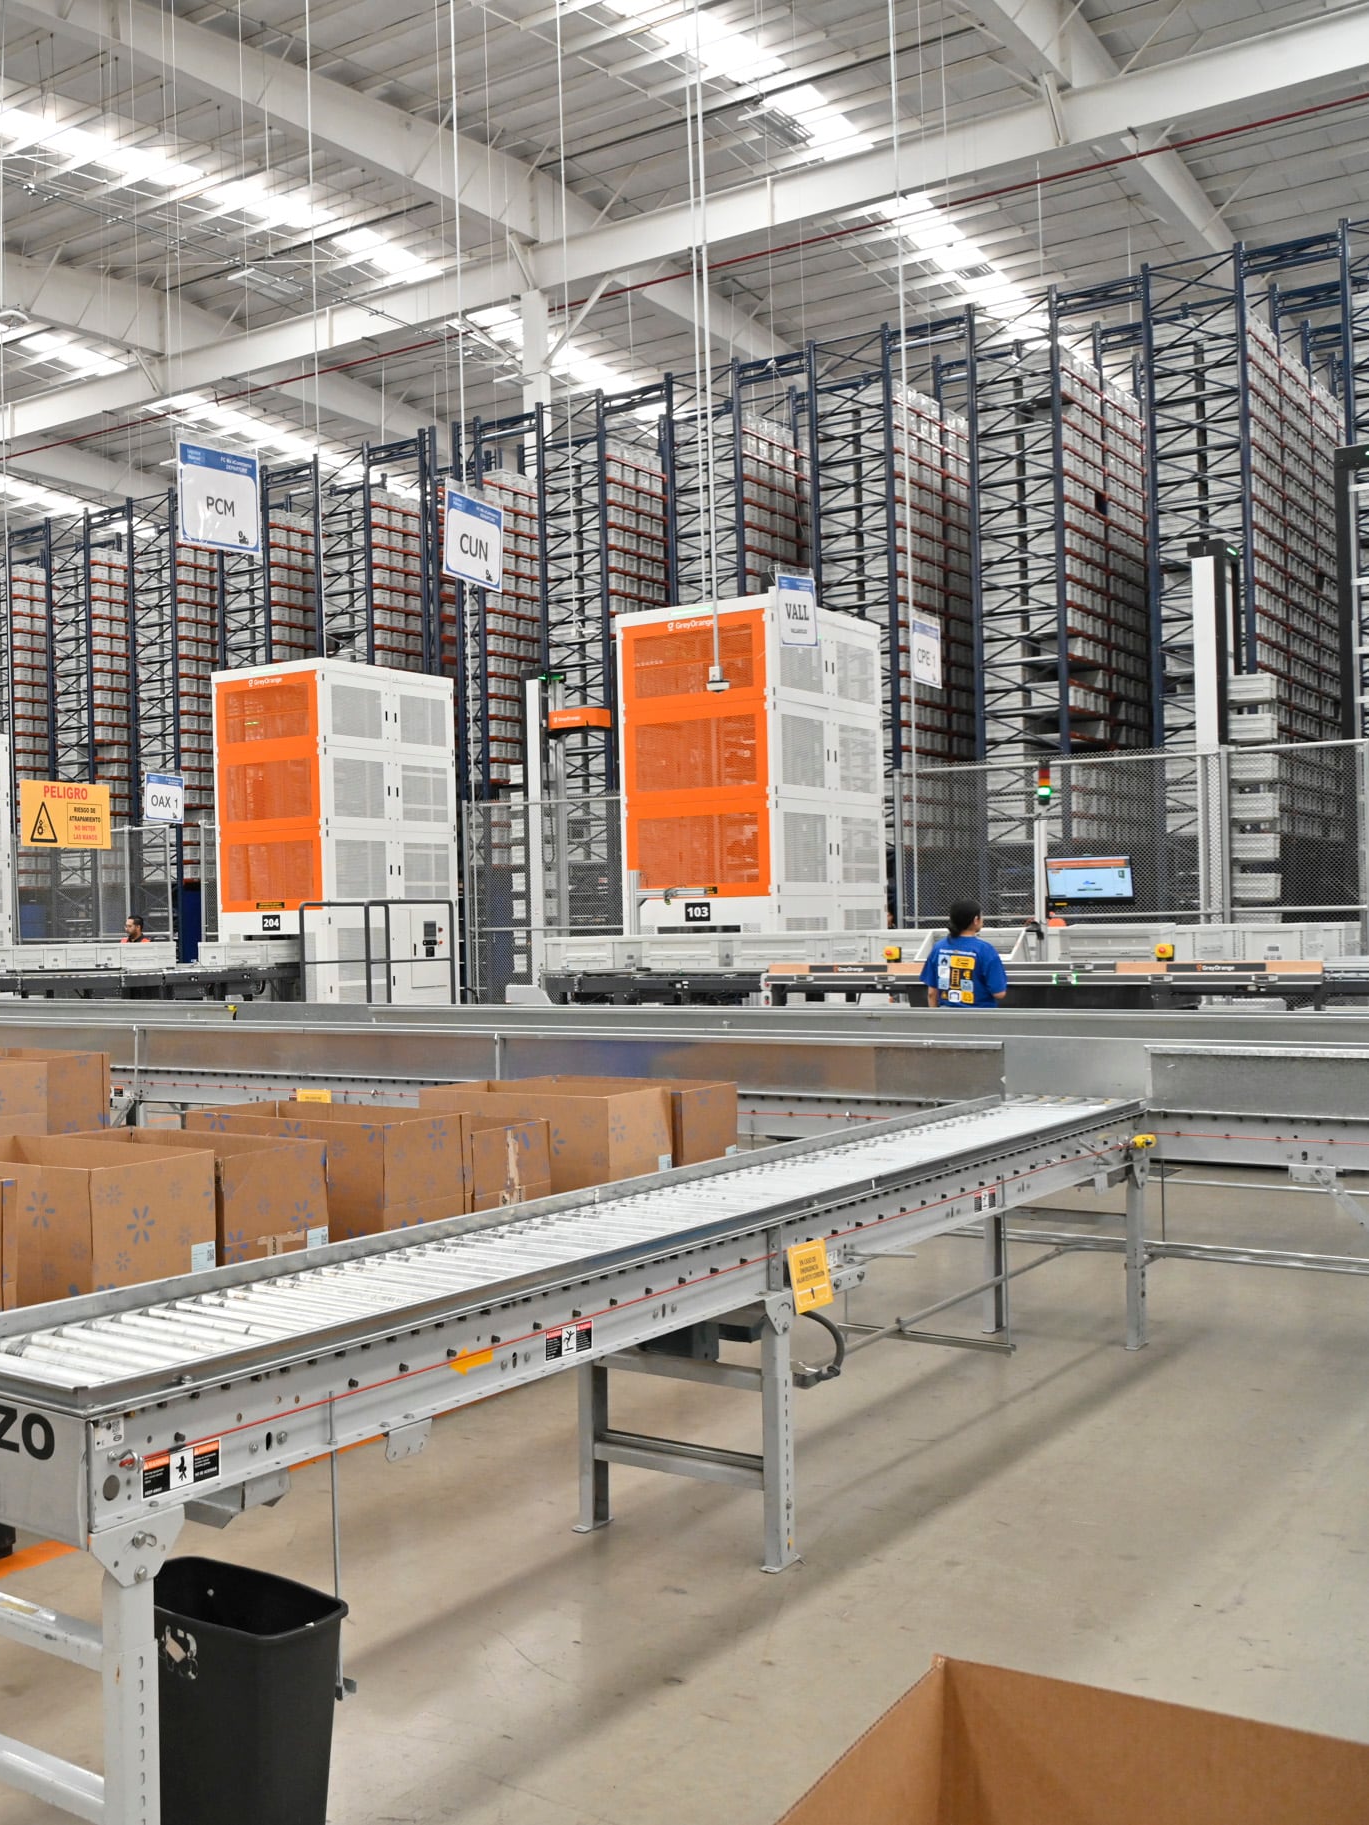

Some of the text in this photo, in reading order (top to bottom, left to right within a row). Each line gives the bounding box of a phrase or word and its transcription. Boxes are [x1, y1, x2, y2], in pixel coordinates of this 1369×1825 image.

[206, 496, 235, 518] PCM
[460, 533, 488, 562] CUN
[785, 603, 809, 621] VALL
[917, 648, 936, 669] CPE 1
[43, 785, 88, 800] PELIGRO
[151, 794, 178, 809] OAX 1
[69, 815, 101, 823] ATRAPAMIENTO
[687, 906, 709, 918] 103
[263, 918, 279, 928] 204
